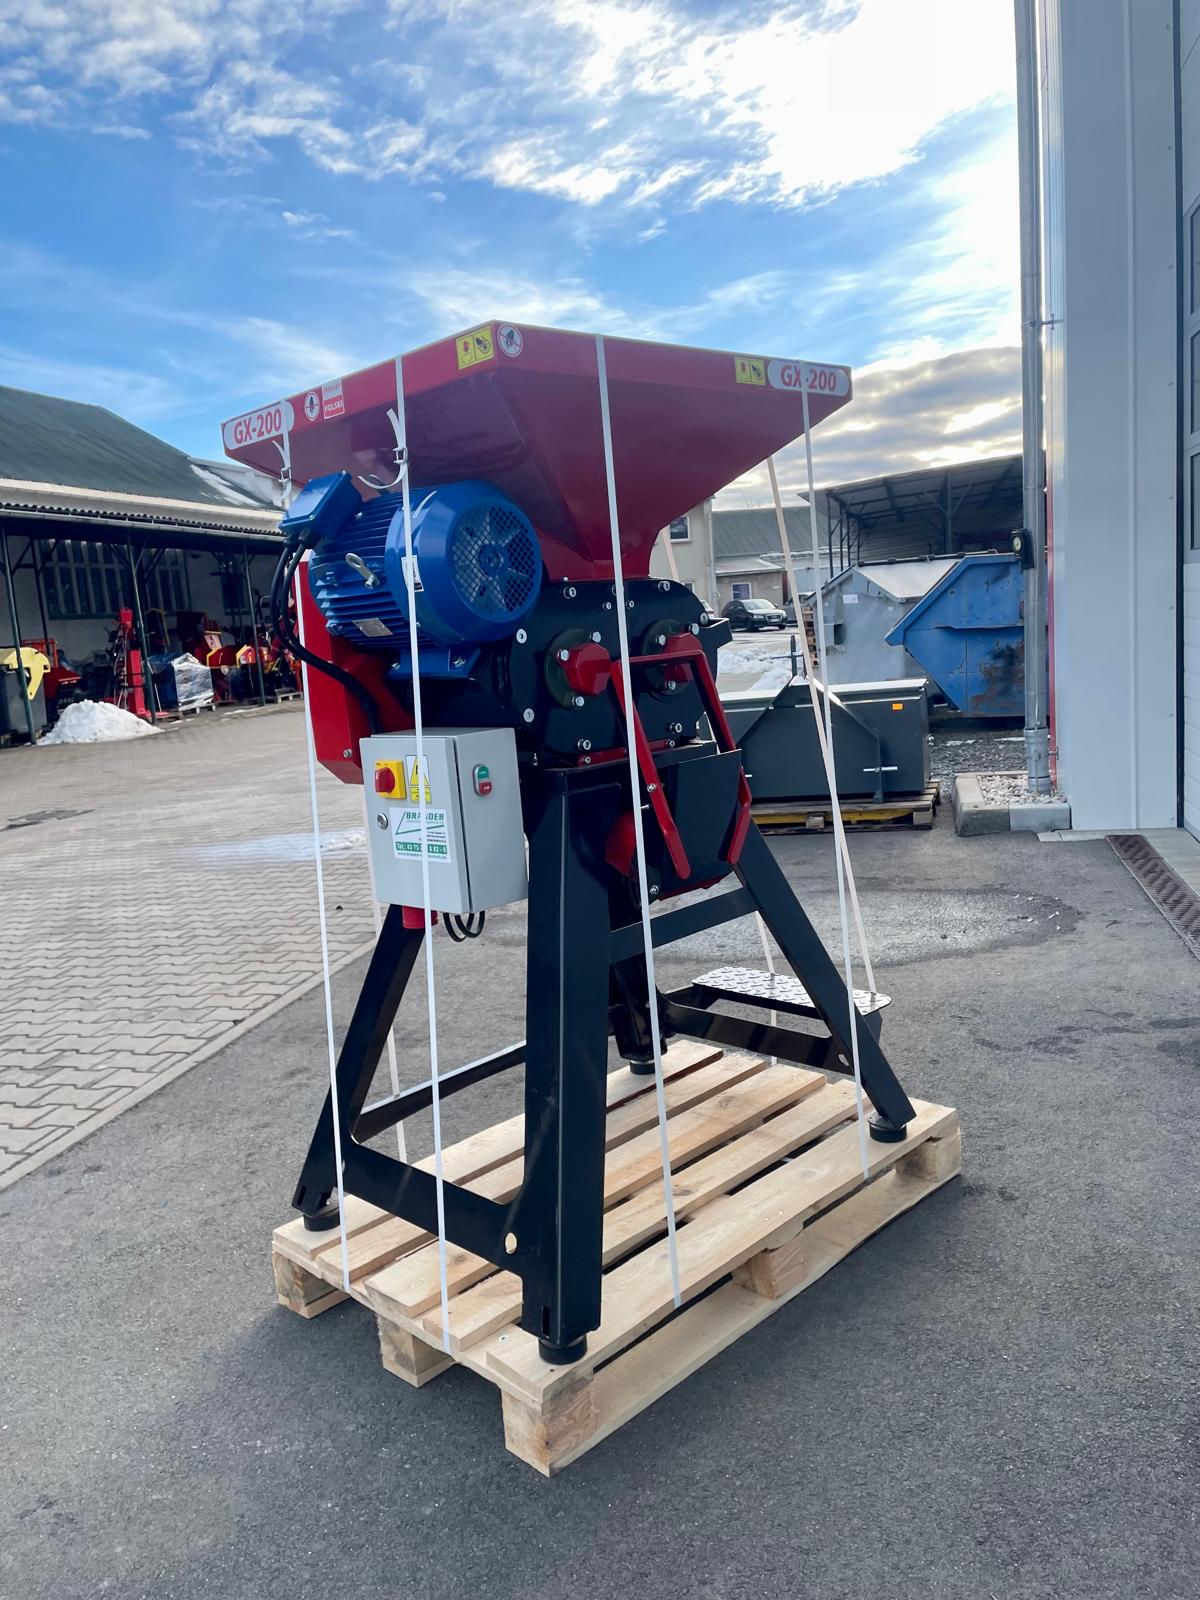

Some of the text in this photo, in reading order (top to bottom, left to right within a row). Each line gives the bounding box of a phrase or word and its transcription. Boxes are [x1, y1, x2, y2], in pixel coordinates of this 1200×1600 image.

[324, 399, 343, 411] POLSKI
[234, 408, 282, 444] GX-200
[406, 811, 445, 821] BRADER
